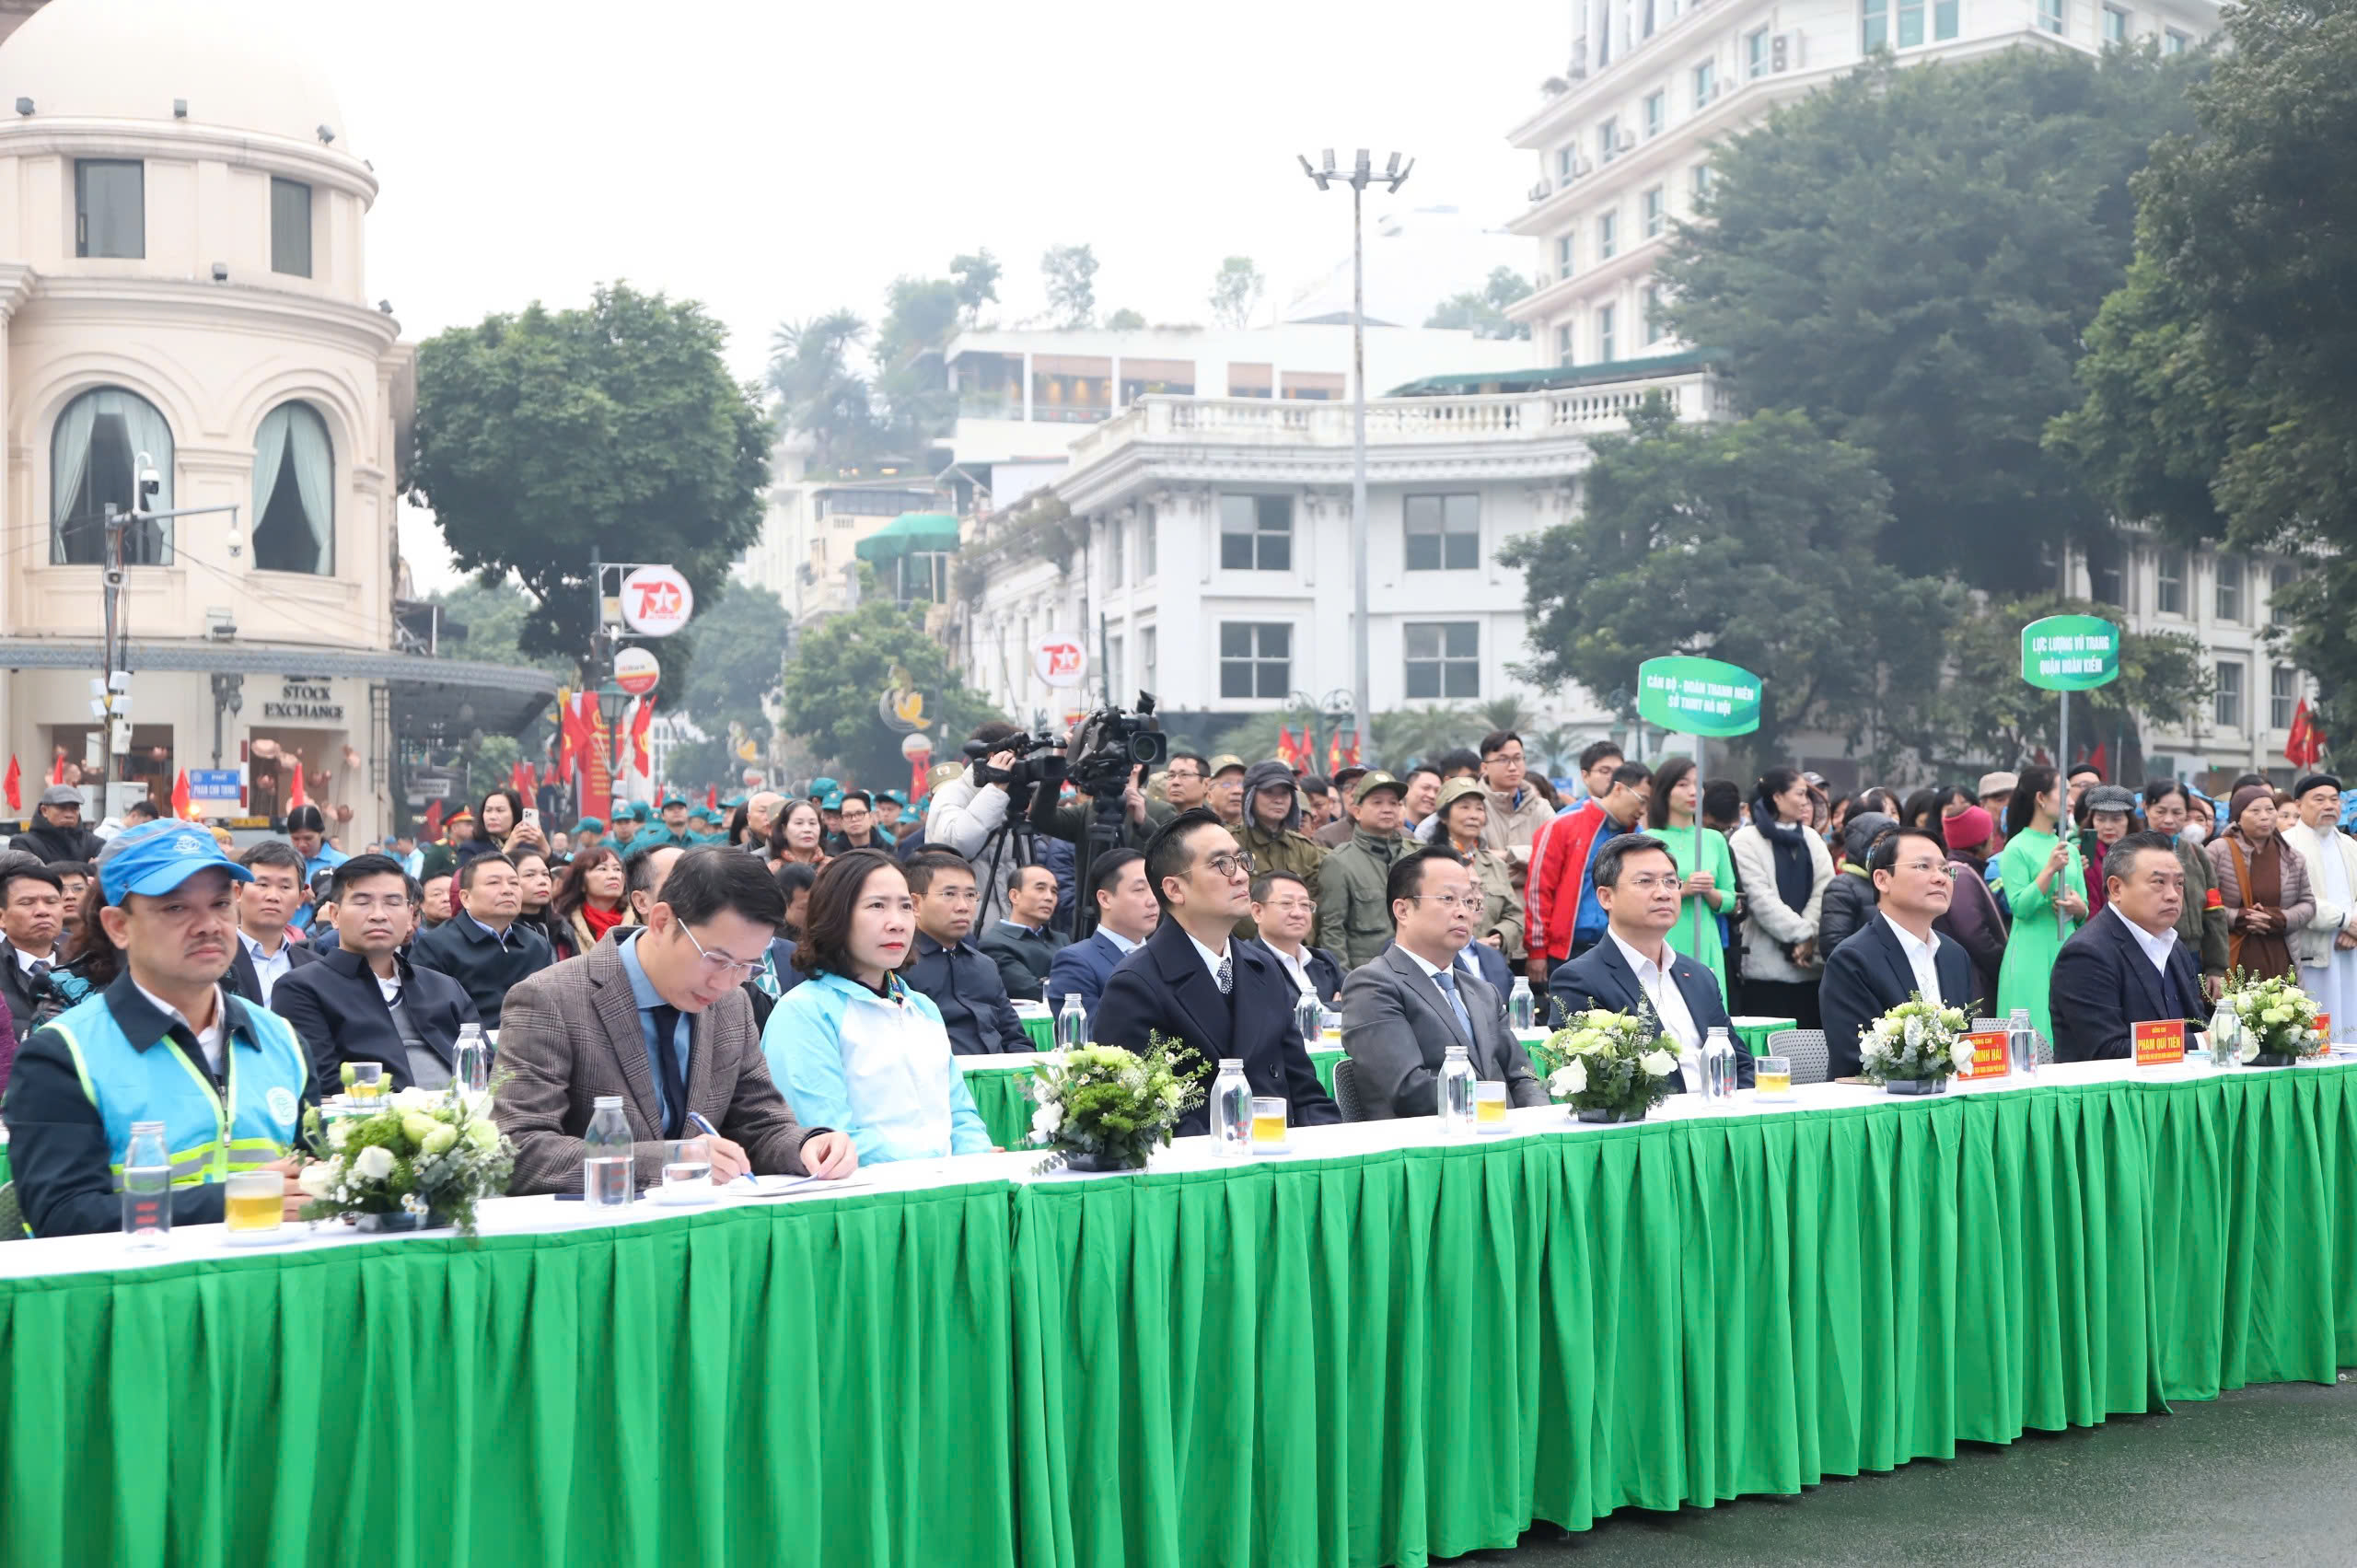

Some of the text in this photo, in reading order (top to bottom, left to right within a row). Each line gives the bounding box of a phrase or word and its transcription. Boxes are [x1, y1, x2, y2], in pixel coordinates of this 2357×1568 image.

[2085, 635, 2109, 650] TRANG
[283, 685, 331, 701] STOCK
[1708, 682, 1733, 698] THANH
[264, 703, 343, 719] EXCHANGE
[2137, 1038, 2155, 1052] PHẠM
